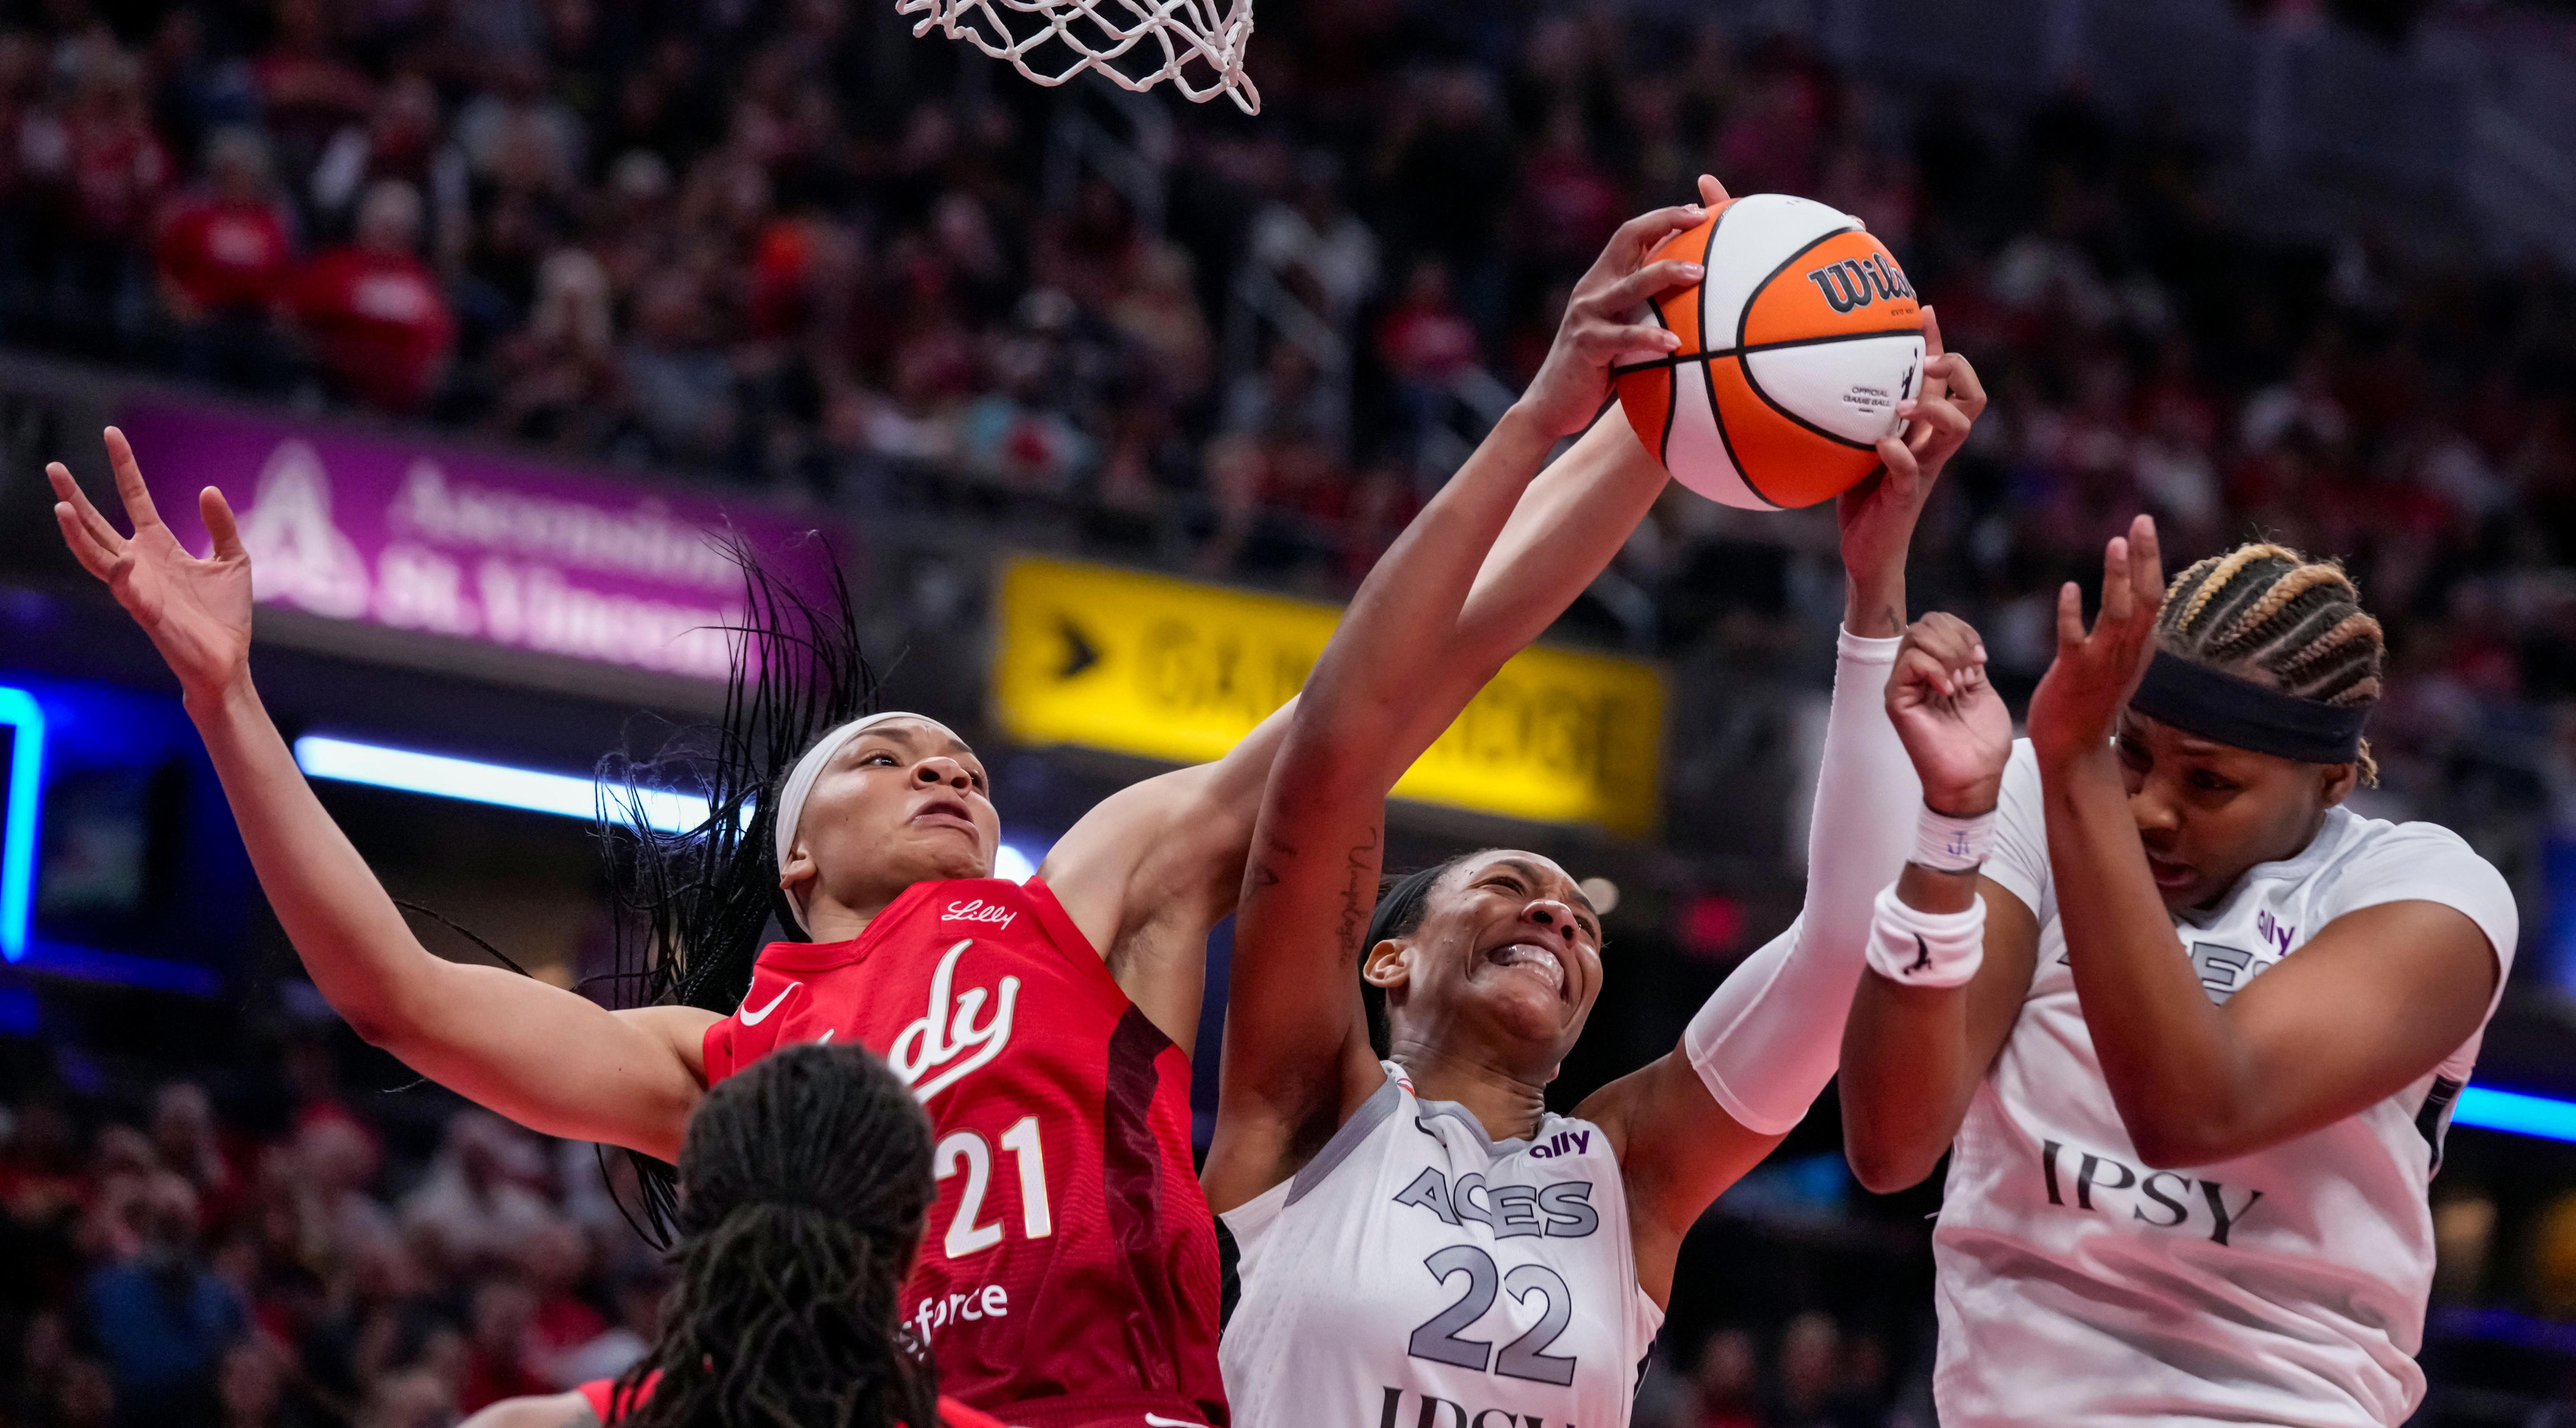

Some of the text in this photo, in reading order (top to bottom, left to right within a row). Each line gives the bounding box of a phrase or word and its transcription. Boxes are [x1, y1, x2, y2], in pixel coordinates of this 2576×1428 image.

[1843, 395, 1870, 405] GAME
[1852, 386, 1888, 397] OFFICIAL
[941, 899, 1017, 930] Lilly
[2257, 909, 2296, 956] ally
[818, 938, 1021, 1105] dy
[1529, 1130, 1590, 1159] ally
[933, 1115, 1053, 1259] 21
[1393, 1166, 1600, 1240] ACES
[2042, 1138, 2264, 1247] IPSY
[1408, 1244, 1578, 1387] 22
